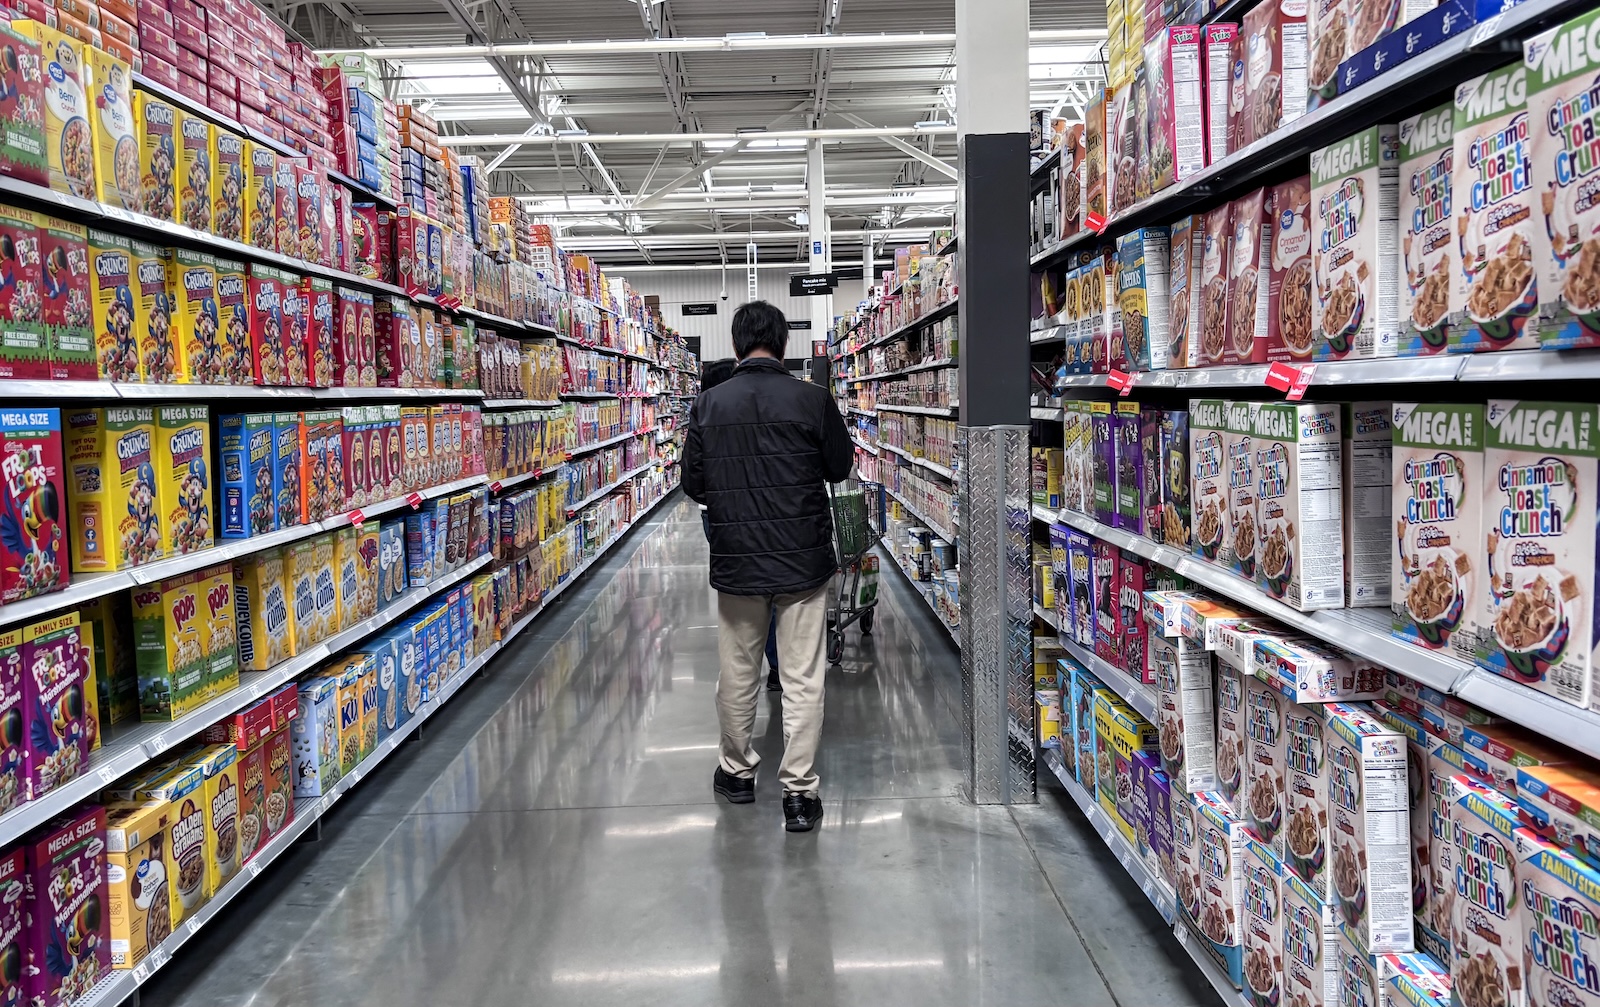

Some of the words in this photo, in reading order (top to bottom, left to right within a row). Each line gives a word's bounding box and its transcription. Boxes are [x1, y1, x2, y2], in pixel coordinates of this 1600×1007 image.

[1173, 31, 1194, 44] Trix
[1211, 29, 1231, 42] Trix
[58, 89, 76, 107] Berry
[111, 108, 126, 127] Berry
[146, 103, 173, 125] CRUNCH
[182, 119, 208, 139] CRUNCH
[218, 135, 241, 154] CRUNCH
[252, 150, 273, 167] CRUNCH
[1318, 140, 1364, 183] MEGA
[1479, 140, 1524, 183] Toast
[298, 181, 320, 199] CRUNCH
[1320, 181, 1357, 217] Cinnamon
[1418, 175, 1450, 208] Toast
[49, 218, 68, 231] FAMILY
[69, 223, 81, 234] SIZE
[1325, 202, 1349, 231] Toast
[89, 229, 114, 245] FAMILY
[116, 234, 130, 248] SIZE
[1143, 231, 1166, 239] Cheerios
[1280, 234, 1307, 247] Cinnamon
[1321, 212, 1357, 250] Crunch
[15, 237, 38, 254] FROOT
[67, 248, 86, 263] FROOT
[132, 240, 151, 254] FAMILY
[152, 245, 165, 257] SIZE
[178, 249, 200, 262] FAMILY
[201, 254, 214, 265] SIZE
[1285, 244, 1299, 255] Crunch
[19, 251, 40, 268] LOOPS
[70, 261, 88, 276] LOOPS
[96, 255, 129, 275] CRUNCH
[252, 263, 268, 275] FAMILY
[138, 263, 165, 282] CRUNCH
[184, 271, 214, 289] CRUNCH
[1120, 270, 1141, 289] Cheerios
[217, 279, 244, 296] CRUNCH
[260, 282, 275, 294] CAP'N
[256, 292, 280, 312] CRUNCH
[1, 413, 28, 426] MEGA
[29, 413, 49, 425] SIZE
[69, 413, 97, 424] CRUNCH
[107, 409, 135, 423] MEGA
[137, 408, 153, 421] SIZE
[162, 408, 188, 420] MEGA
[189, 407, 207, 419] SIZE
[247, 415, 263, 424] FAMILY
[264, 415, 272, 423] SIZE
[1194, 403, 1222, 427] MEGA
[1300, 411, 1335, 424] Cinnamon
[1305, 418, 1329, 429] Toast
[1354, 408, 1389, 421] Cinnamon
[1359, 415, 1383, 425] Toast
[1302, 423, 1336, 438] Crunch
[1356, 420, 1390, 435] Crunch
[1402, 411, 1463, 446] MEGA
[1464, 412, 1472, 446] SIZE
[1499, 408, 1577, 449] MEGA
[1579, 411, 1591, 450] SIZE
[117, 433, 150, 459] CRUNCH
[170, 429, 203, 454] CRUNCH
[1, 444, 43, 482] FROOT
[1200, 448, 1214, 466] Toast
[1233, 453, 1249, 471] Toast
[1257, 446, 1284, 466] Cinnamon
[8, 465, 47, 498] LOOPS
[1196, 458, 1219, 480] Crunch
[1261, 459, 1280, 480] Toast
[1404, 456, 1455, 482] Cinnamon
[1500, 461, 1564, 490] Cinnamon
[1259, 475, 1285, 500] Crunch
[1413, 477, 1444, 500] Toast
[1510, 486, 1550, 512] Toast
[1407, 491, 1455, 523] Crunch
[1501, 502, 1562, 537] Crunch
[316, 582, 335, 611] COMB
[342, 572, 357, 601] COMB
[134, 591, 161, 608] POPS
[208, 583, 229, 619] POPS
[296, 592, 314, 622] COMB
[173, 594, 196, 632] POPS
[267, 602, 287, 633] COMB
[34, 619, 57, 635] FAMILY
[59, 617, 73, 629] SIZE
[32, 645, 64, 680] FROOT
[37, 661, 67, 693] LOOPS
[40, 668, 80, 705] Marshmallows
[363, 685, 377, 715] KIX
[1249, 688, 1276, 712] Cinnamon
[1251, 707, 1270, 727] Toast
[1286, 712, 1319, 739] Cinnamon
[1385, 712, 1405, 733] FAMILY
[1405, 723, 1418, 741] SIZE
[1249, 719, 1276, 747] Crunch
[1290, 733, 1312, 754] Toast
[1333, 718, 1348, 737] FAMILY
[1346, 730, 1356, 746] SIZE
[1113, 735, 1134, 758] MOTT'S
[1328, 742, 1355, 772] Cinnamon
[271, 749, 289, 775] SMACKS
[1287, 745, 1318, 778] Crunch
[1330, 762, 1349, 786] Toast
[244, 770, 263, 796] SMACKS
[1329, 776, 1356, 814] Crunch
[213, 791, 237, 814] GOLDEN
[173, 812, 203, 843] GOLDEN
[213, 802, 238, 831] GRAHAMS
[1202, 806, 1216, 823] FAMILY
[1214, 816, 1224, 829] SIZE
[1466, 794, 1495, 823] FAMILY
[1493, 813, 1512, 837] SIZE
[48, 829, 74, 855] MEGA
[77, 817, 97, 840] SIZE
[173, 826, 204, 861] GRAHAMS
[1454, 821, 1507, 870] Cinnamon
[1251, 841, 1266, 859] FAMILY
[1264, 853, 1275, 870] SIZE
[1460, 847, 1495, 884] Toast
[48, 856, 81, 901] FROOT
[143, 876, 160, 894] Graham
[1243, 858, 1272, 891] Cinnamon
[1540, 853, 1578, 890] FAMILY
[1577, 877, 1600, 899] SIZE
[52, 873, 84, 913] LOOPS
[1247, 876, 1266, 899] Toast
[1455, 863, 1507, 919] Crunch
[55, 874, 102, 927] Marshmallows
[1244, 889, 1273, 925] Crunch
[1523, 879, 1599, 940] Cinnamon
[1284, 896, 1313, 934] Cinnamon
[1288, 916, 1308, 943] Toast
[1536, 908, 1583, 959] Toast
[1285, 928, 1314, 970] Crunch
[1530, 928, 1600, 995] Crunch
[1342, 962, 1363, 993] Toast
